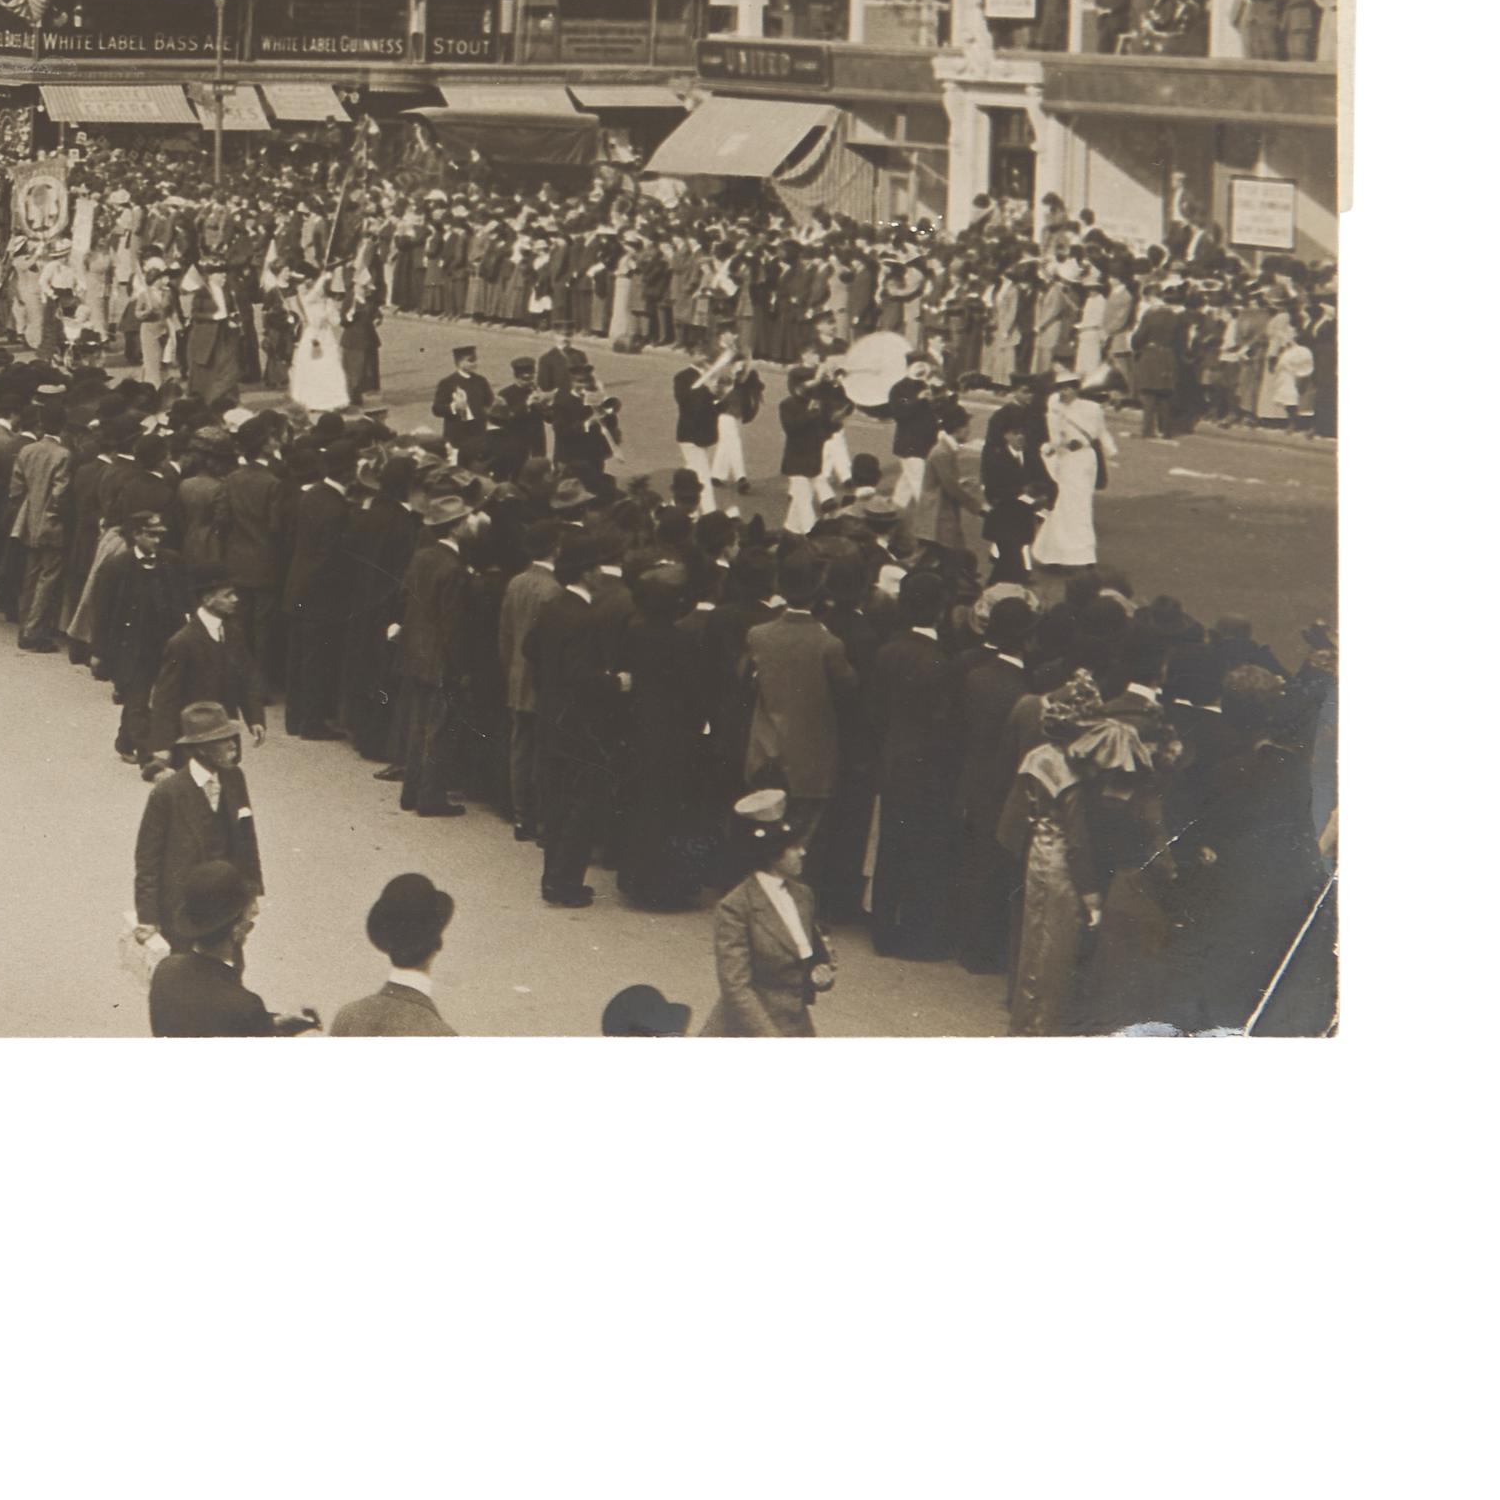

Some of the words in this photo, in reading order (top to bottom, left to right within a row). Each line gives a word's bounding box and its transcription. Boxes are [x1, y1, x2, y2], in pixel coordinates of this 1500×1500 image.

[43, 32, 93, 50] WHITE
[98, 32, 147, 51] LABEL
[154, 33, 199, 51] BASS
[260, 35, 298, 52] WHITE
[302, 36, 337, 52] LABEL
[339, 35, 404, 54] GUINNESS
[433, 37, 492, 55] STOUT
